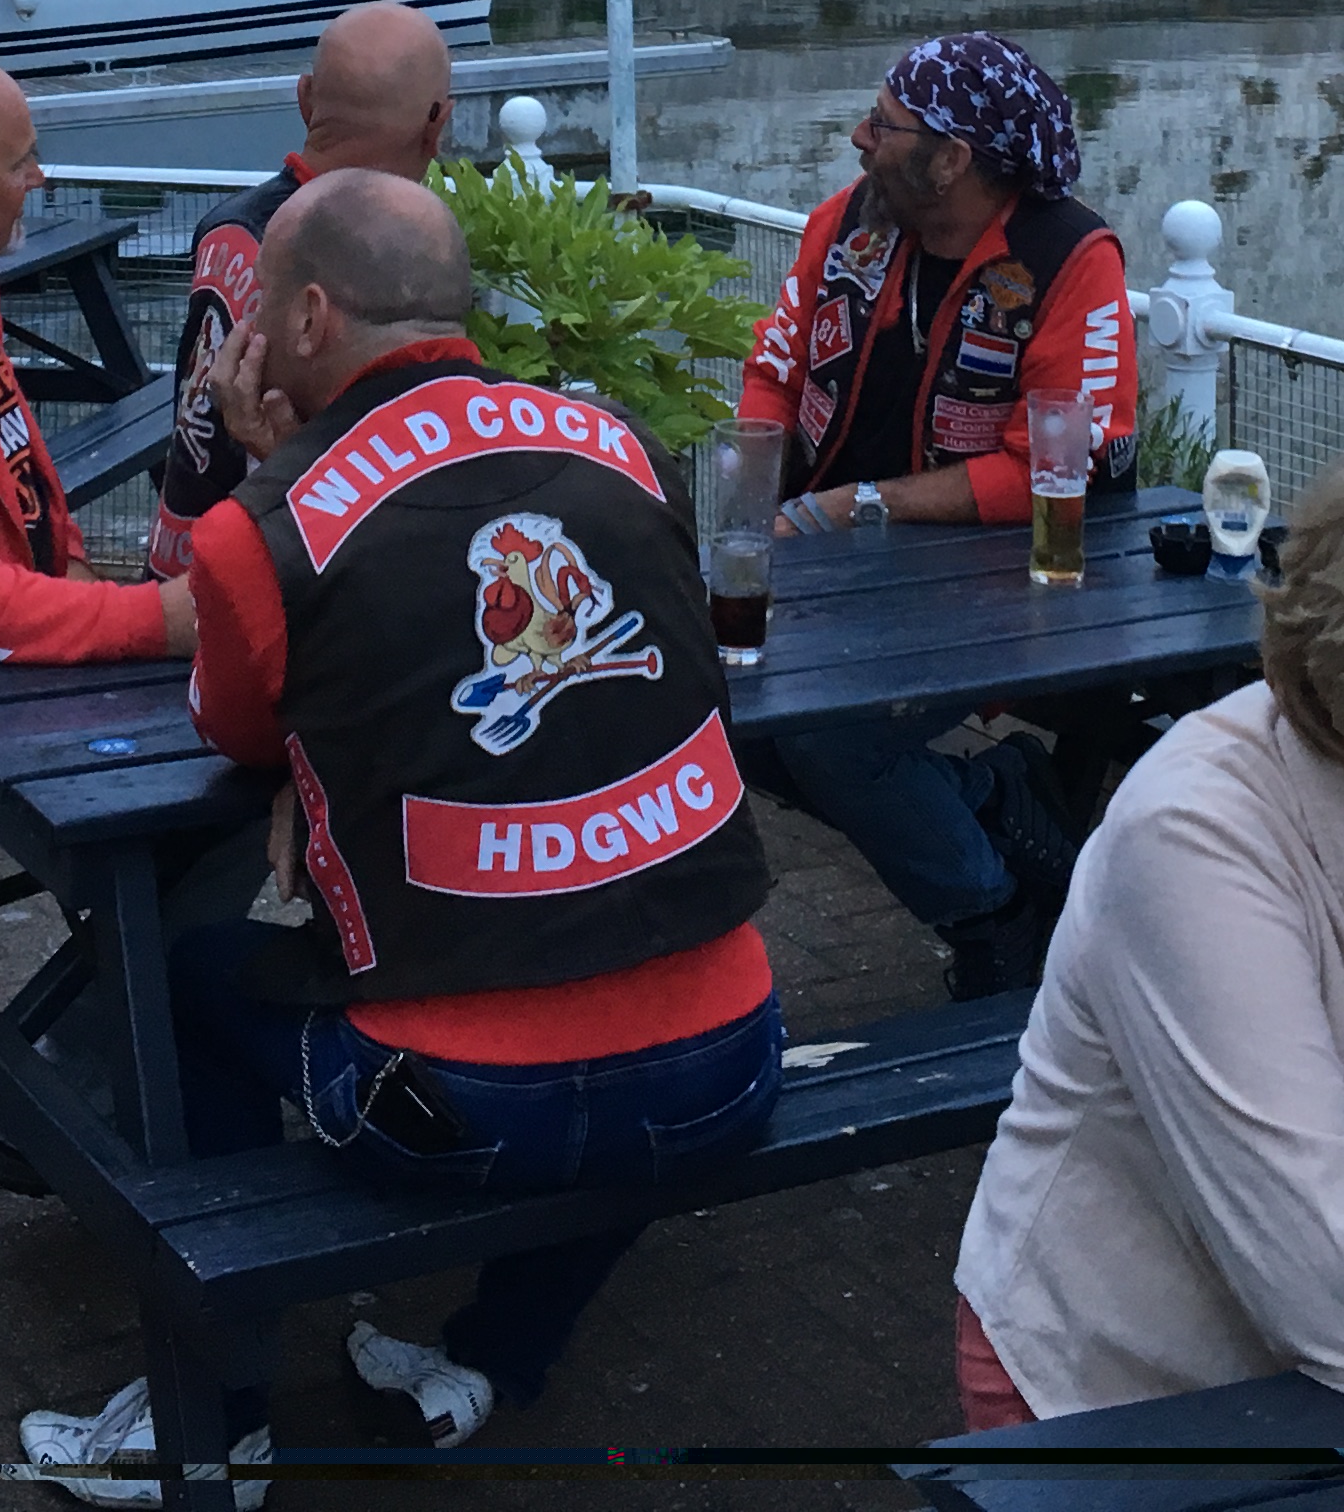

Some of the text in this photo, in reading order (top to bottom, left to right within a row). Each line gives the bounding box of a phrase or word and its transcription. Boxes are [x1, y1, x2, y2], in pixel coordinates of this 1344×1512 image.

[298, 394, 633, 518] WILD COCK
[476, 762, 716, 873] HDGWC
